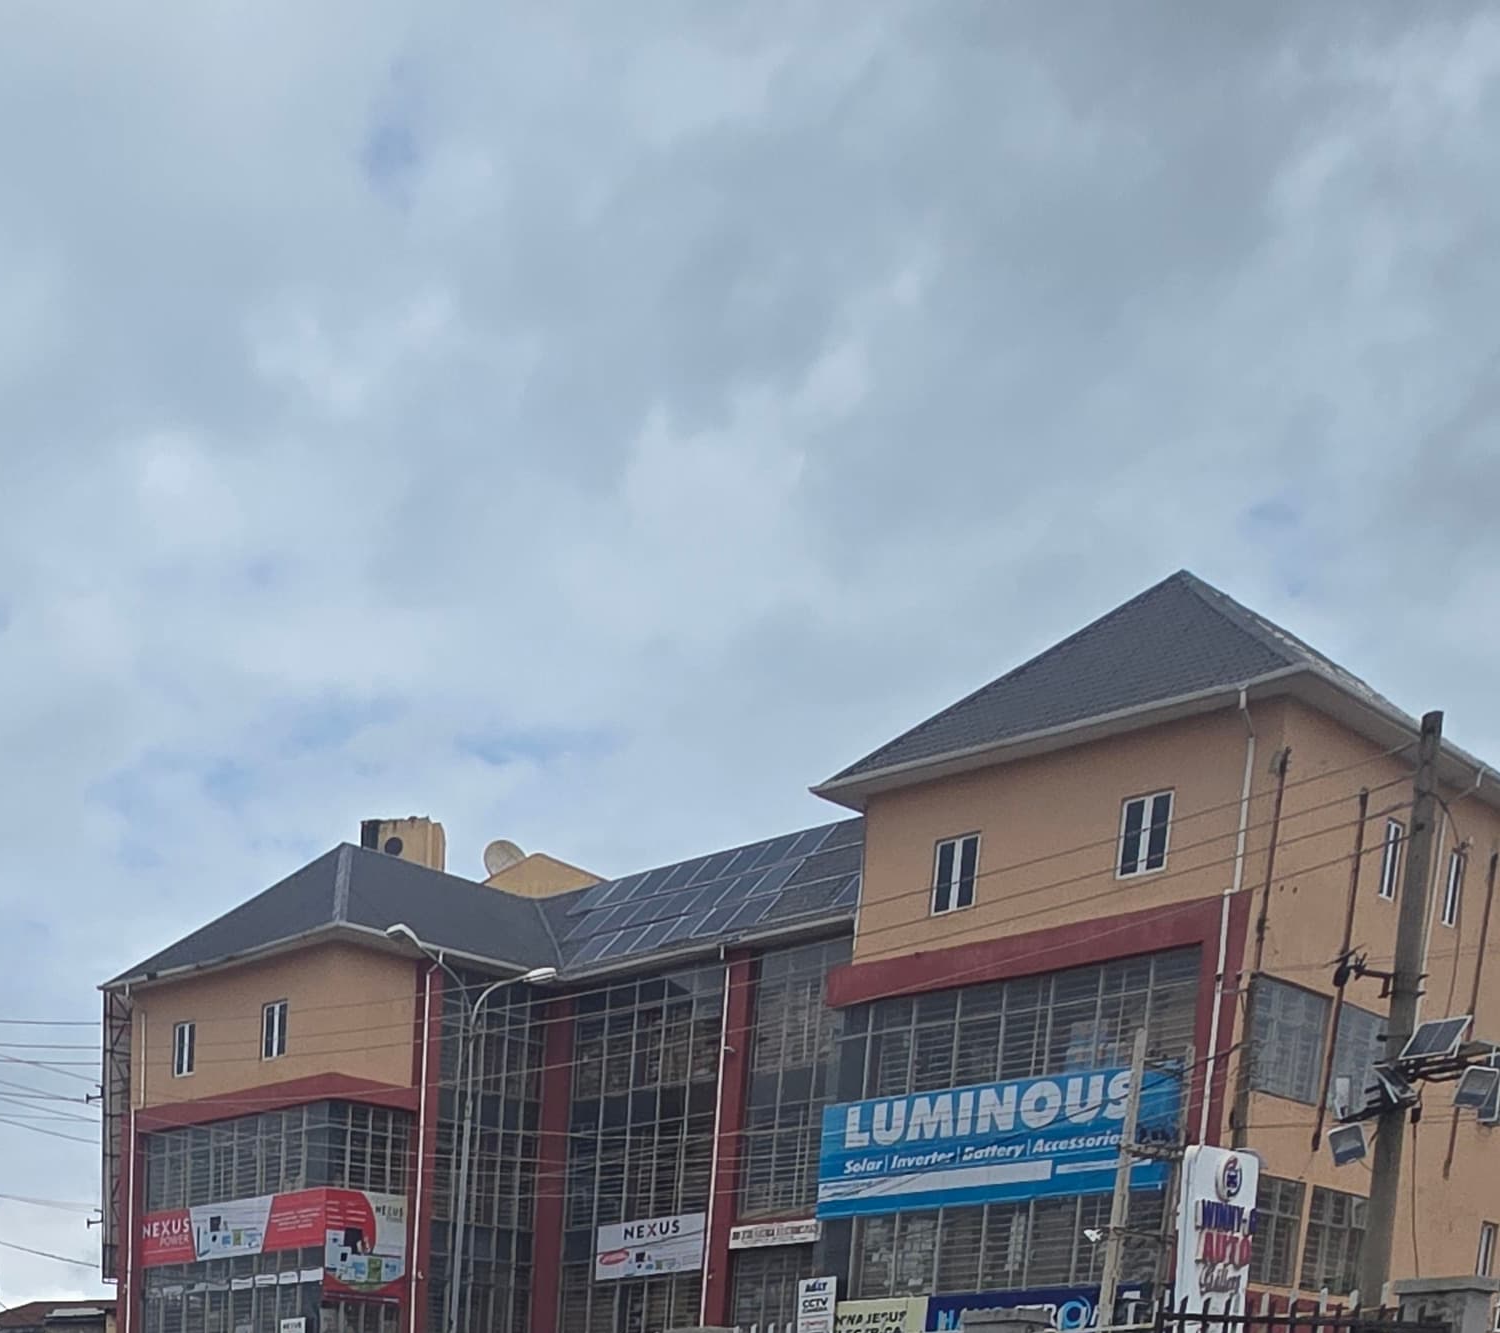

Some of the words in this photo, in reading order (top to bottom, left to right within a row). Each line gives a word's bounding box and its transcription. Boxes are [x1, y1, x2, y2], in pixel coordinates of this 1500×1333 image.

[845, 1070, 1133, 1149] LUMINOUS
[844, 1158, 883, 1174] Solar
[891, 1151, 954, 1169] Inverter
[962, 1143, 1026, 1161] Battery
[143, 1218, 190, 1239] NEXUS
[623, 1219, 681, 1240] NEXUS
[1202, 1231, 1252, 1265] AUTO
[802, 1298, 828, 1308] CCTV
